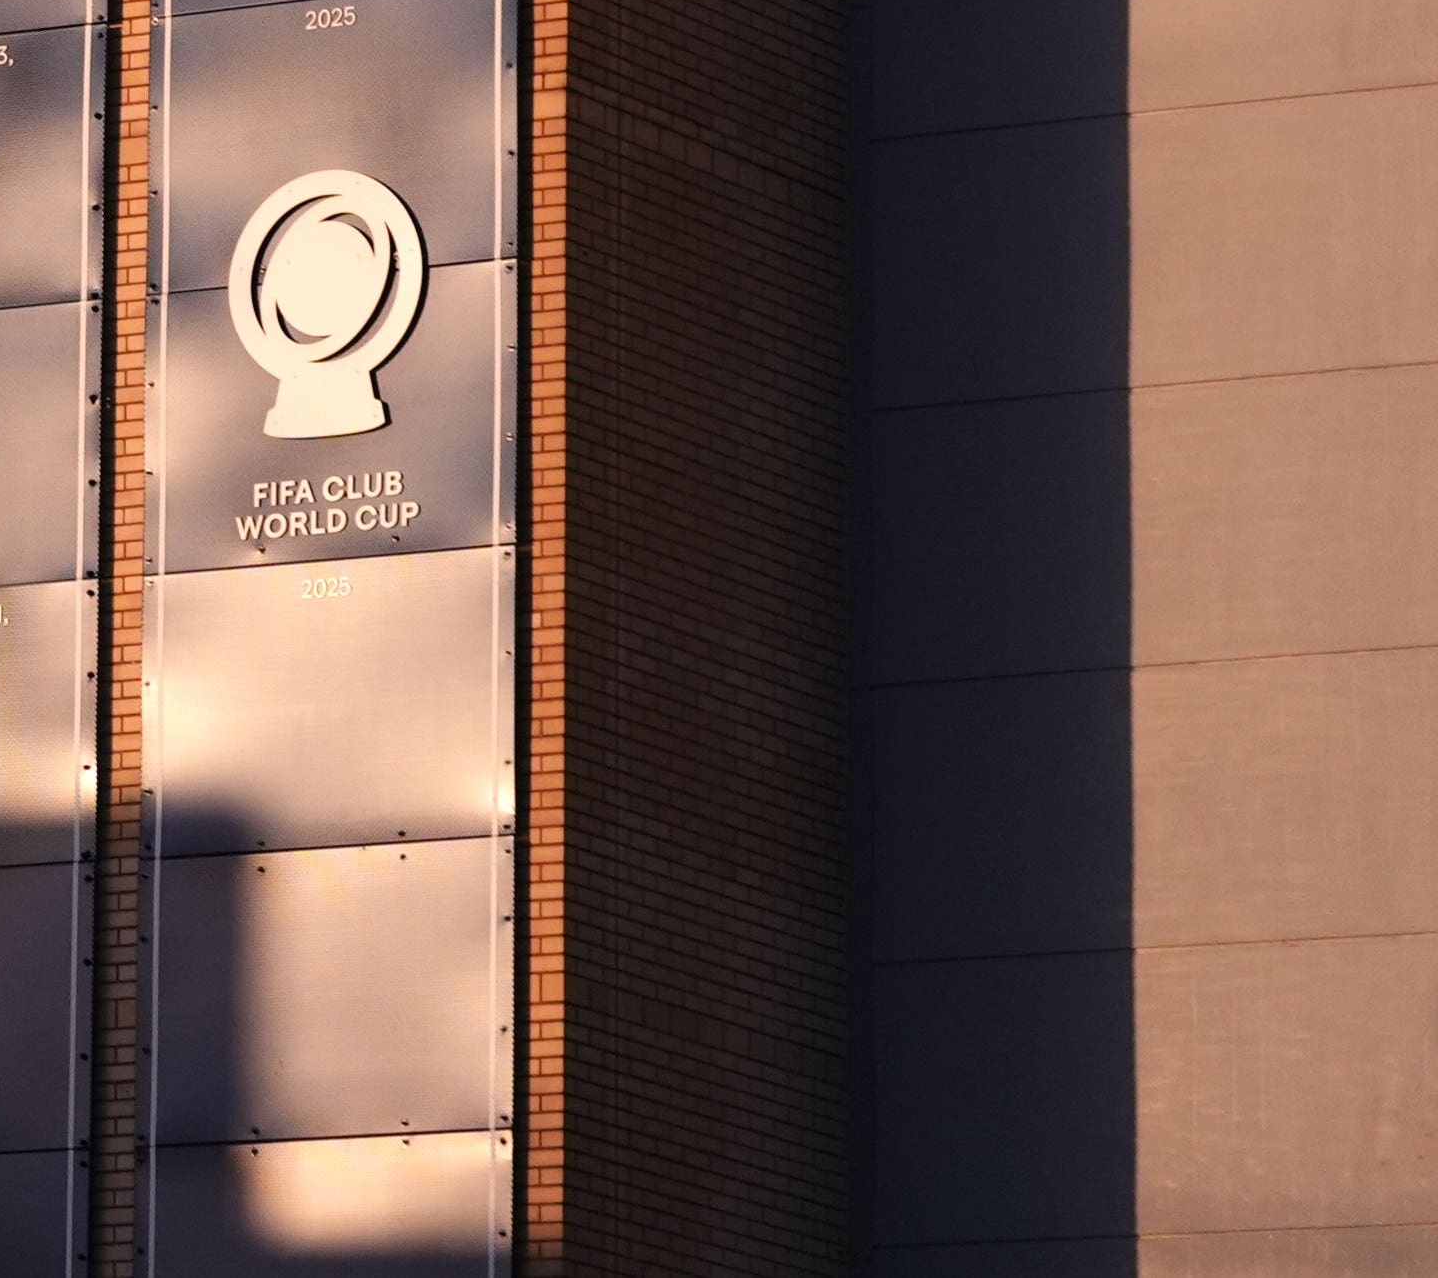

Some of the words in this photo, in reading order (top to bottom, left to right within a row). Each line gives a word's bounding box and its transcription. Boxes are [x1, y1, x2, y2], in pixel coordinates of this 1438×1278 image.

[305, 7, 356, 30] 2025
[253, 479, 315, 507] FIFA
[322, 471, 403, 503] CLUB
[236, 507, 351, 541] WORLD
[358, 501, 420, 530] CUP
[301, 577, 351, 600] 2025
